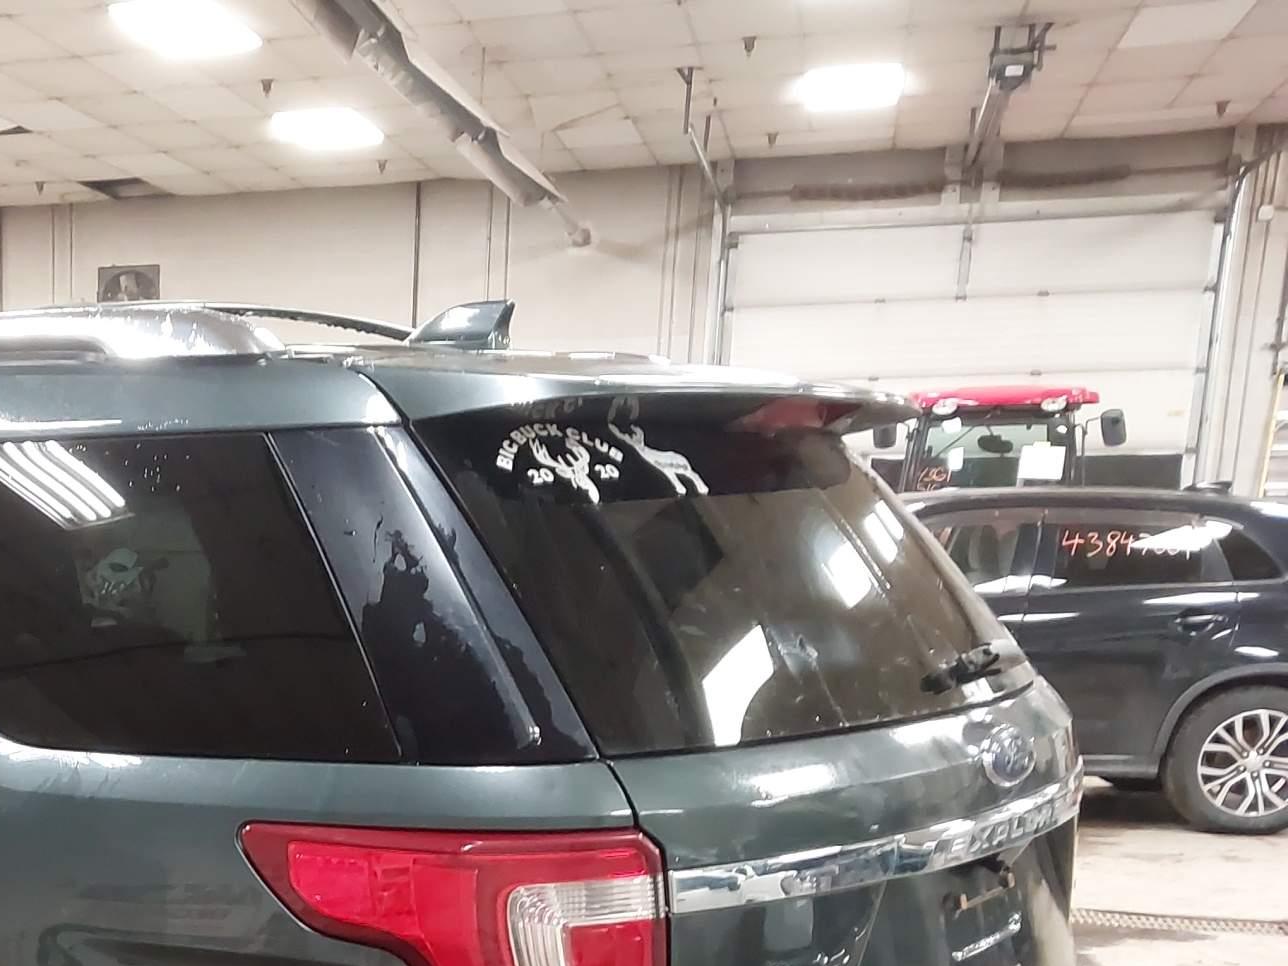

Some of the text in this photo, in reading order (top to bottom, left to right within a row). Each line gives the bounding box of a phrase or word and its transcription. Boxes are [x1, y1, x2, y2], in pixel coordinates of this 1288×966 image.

[509, 423, 563, 446] BUCK
[565, 427, 624, 463] CLUB
[527, 467, 554, 485] 20
[594, 463, 620, 480] 20
